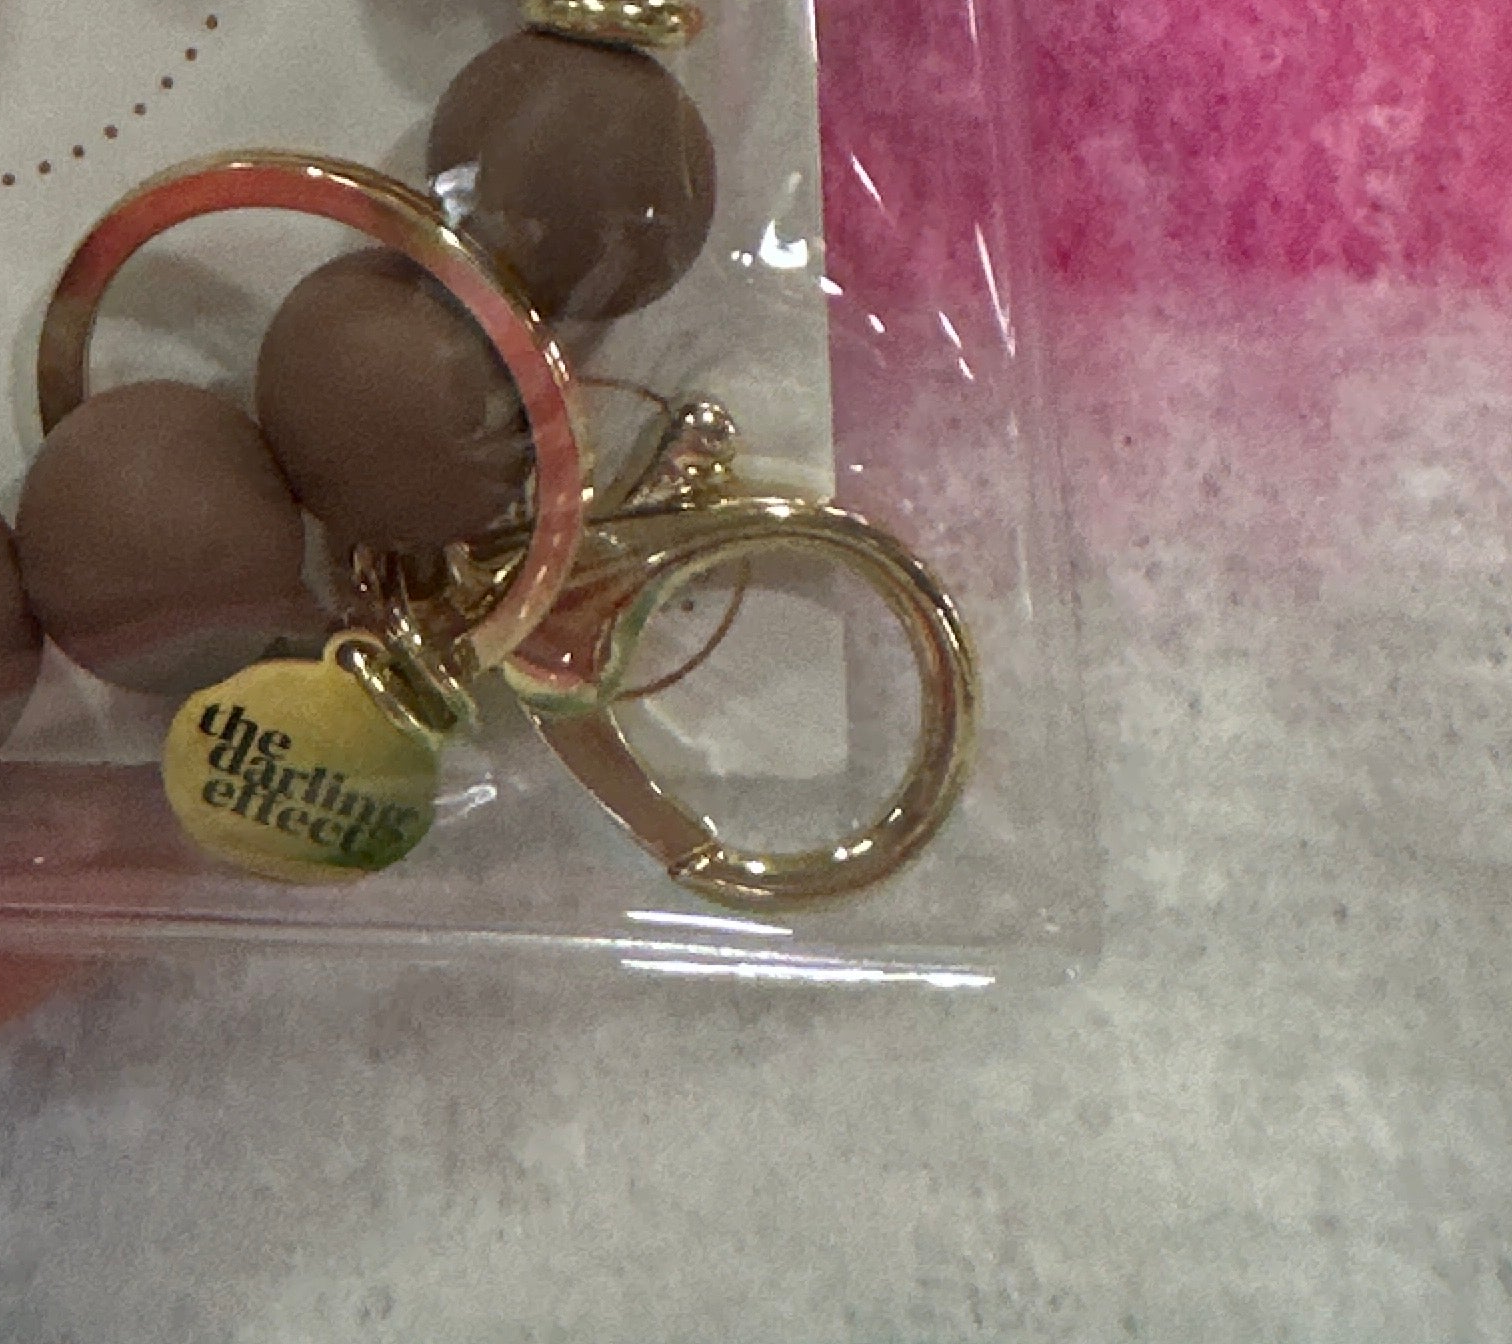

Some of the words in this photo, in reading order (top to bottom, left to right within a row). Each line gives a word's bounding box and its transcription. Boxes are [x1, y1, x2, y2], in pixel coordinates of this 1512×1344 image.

[199, 703, 292, 758] the
[202, 777, 363, 854] effect
[208, 740, 420, 844] darling
